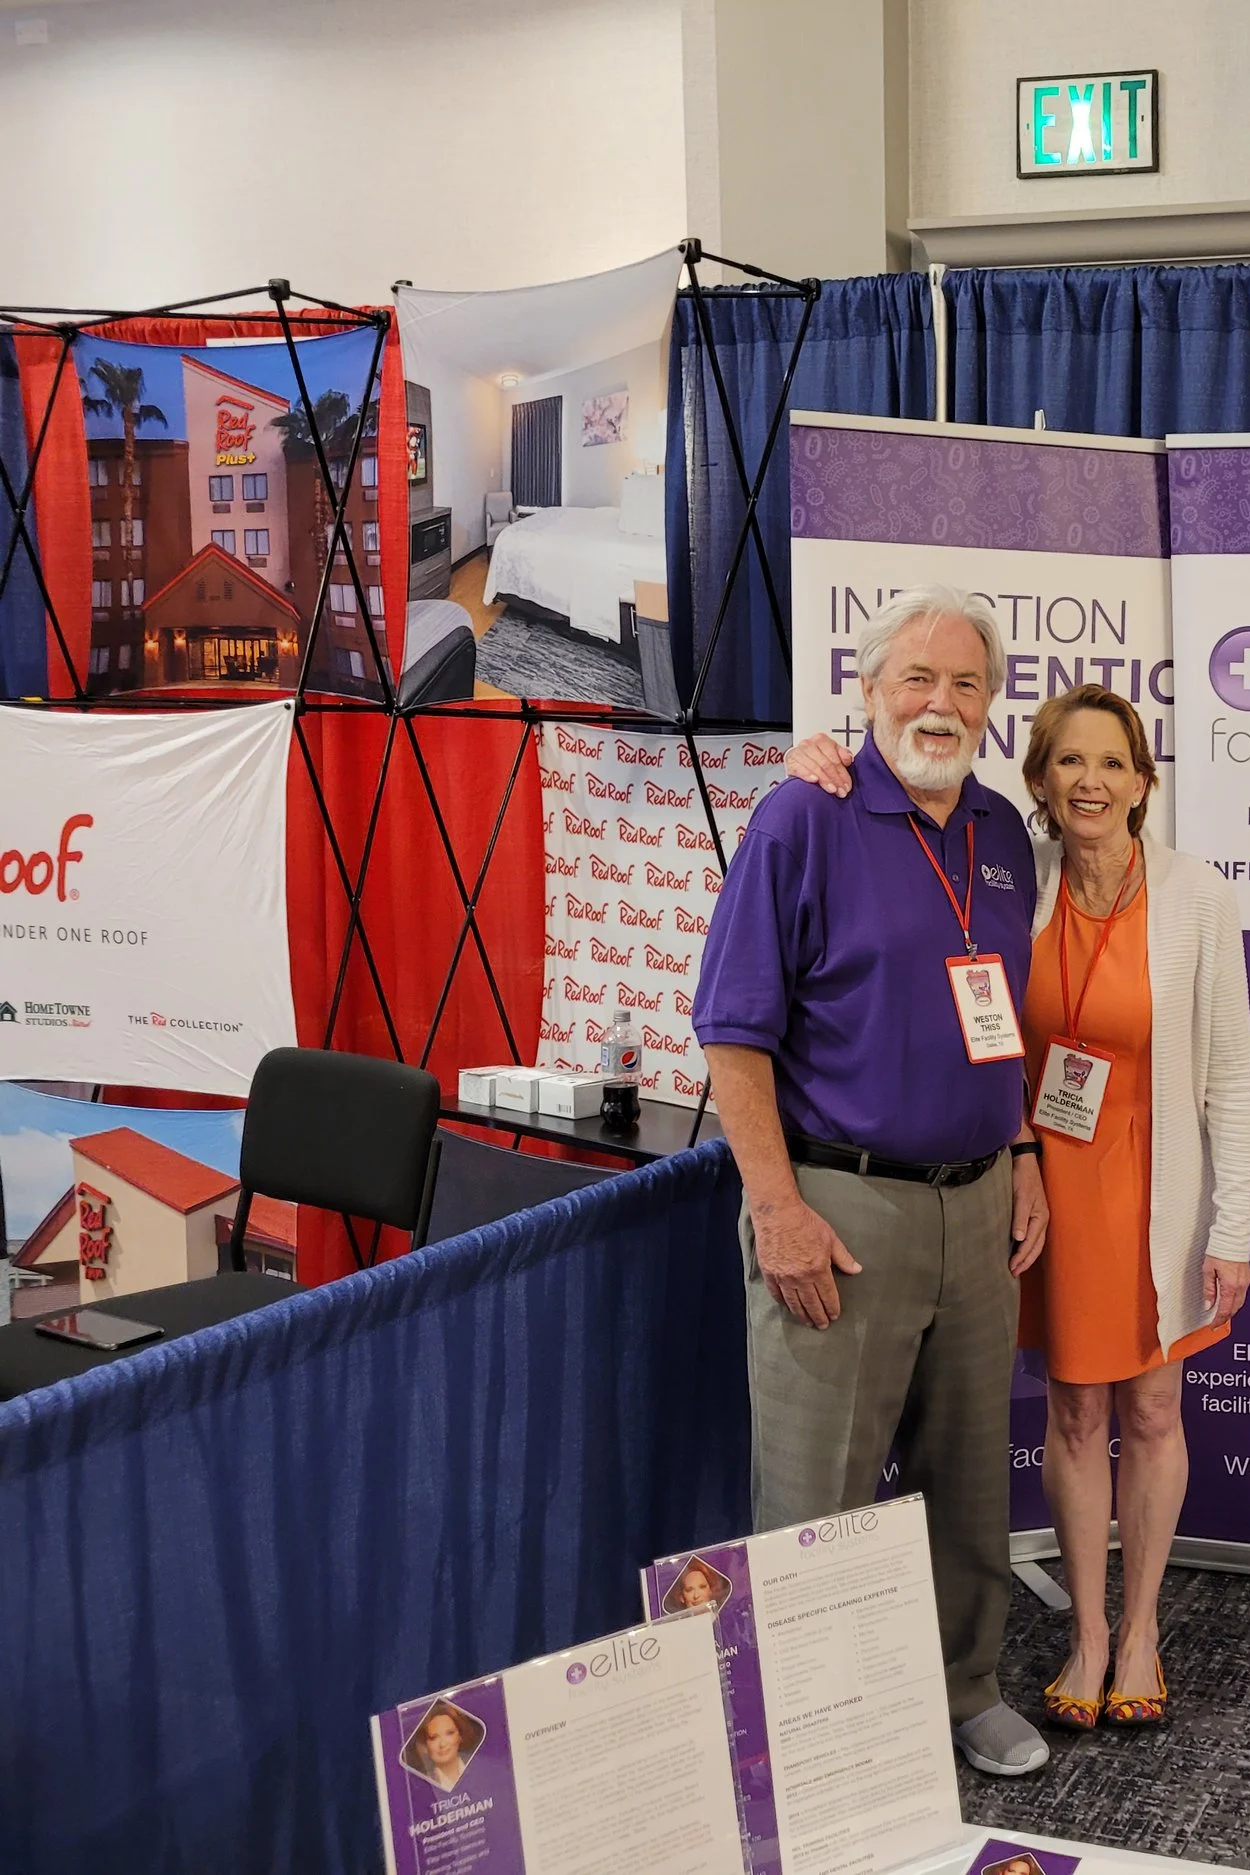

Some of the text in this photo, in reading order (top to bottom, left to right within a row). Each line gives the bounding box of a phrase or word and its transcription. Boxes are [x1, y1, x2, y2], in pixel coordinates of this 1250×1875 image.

[1034, 80, 1147, 165] EXIT
[217, 409, 249, 431] Red
[216, 424, 257, 452] Roof
[831, 586, 1126, 645] INTION
[679, 748, 731, 769] ReRoof
[3, 924, 148, 945] NDER ONE ROOF
[25, 1017, 68, 1028] STUDIOS
[128, 1015, 148, 1025] THE
[974, 1014, 1003, 1024] WESTON
[981, 1023, 1001, 1032] THISS
[1043, 1093, 1095, 1115] HOLDERMAN
[1058, 1089, 1083, 1103] TRICIA
[818, 1511, 879, 1543] elite
[762, 1572, 798, 1587] OUR OATH
[767, 1586, 899, 1630] DISEASE SPECIFIC CLEANING EXPERTISE
[589, 1637, 660, 1678] elite
[778, 1695, 863, 1727] AREAS WE HAVE WORKED
[524, 1720, 567, 1740] OVERVIEW
[430, 1792, 471, 1814] TRICIA
[409, 1797, 493, 1837] HOLDERMAN
